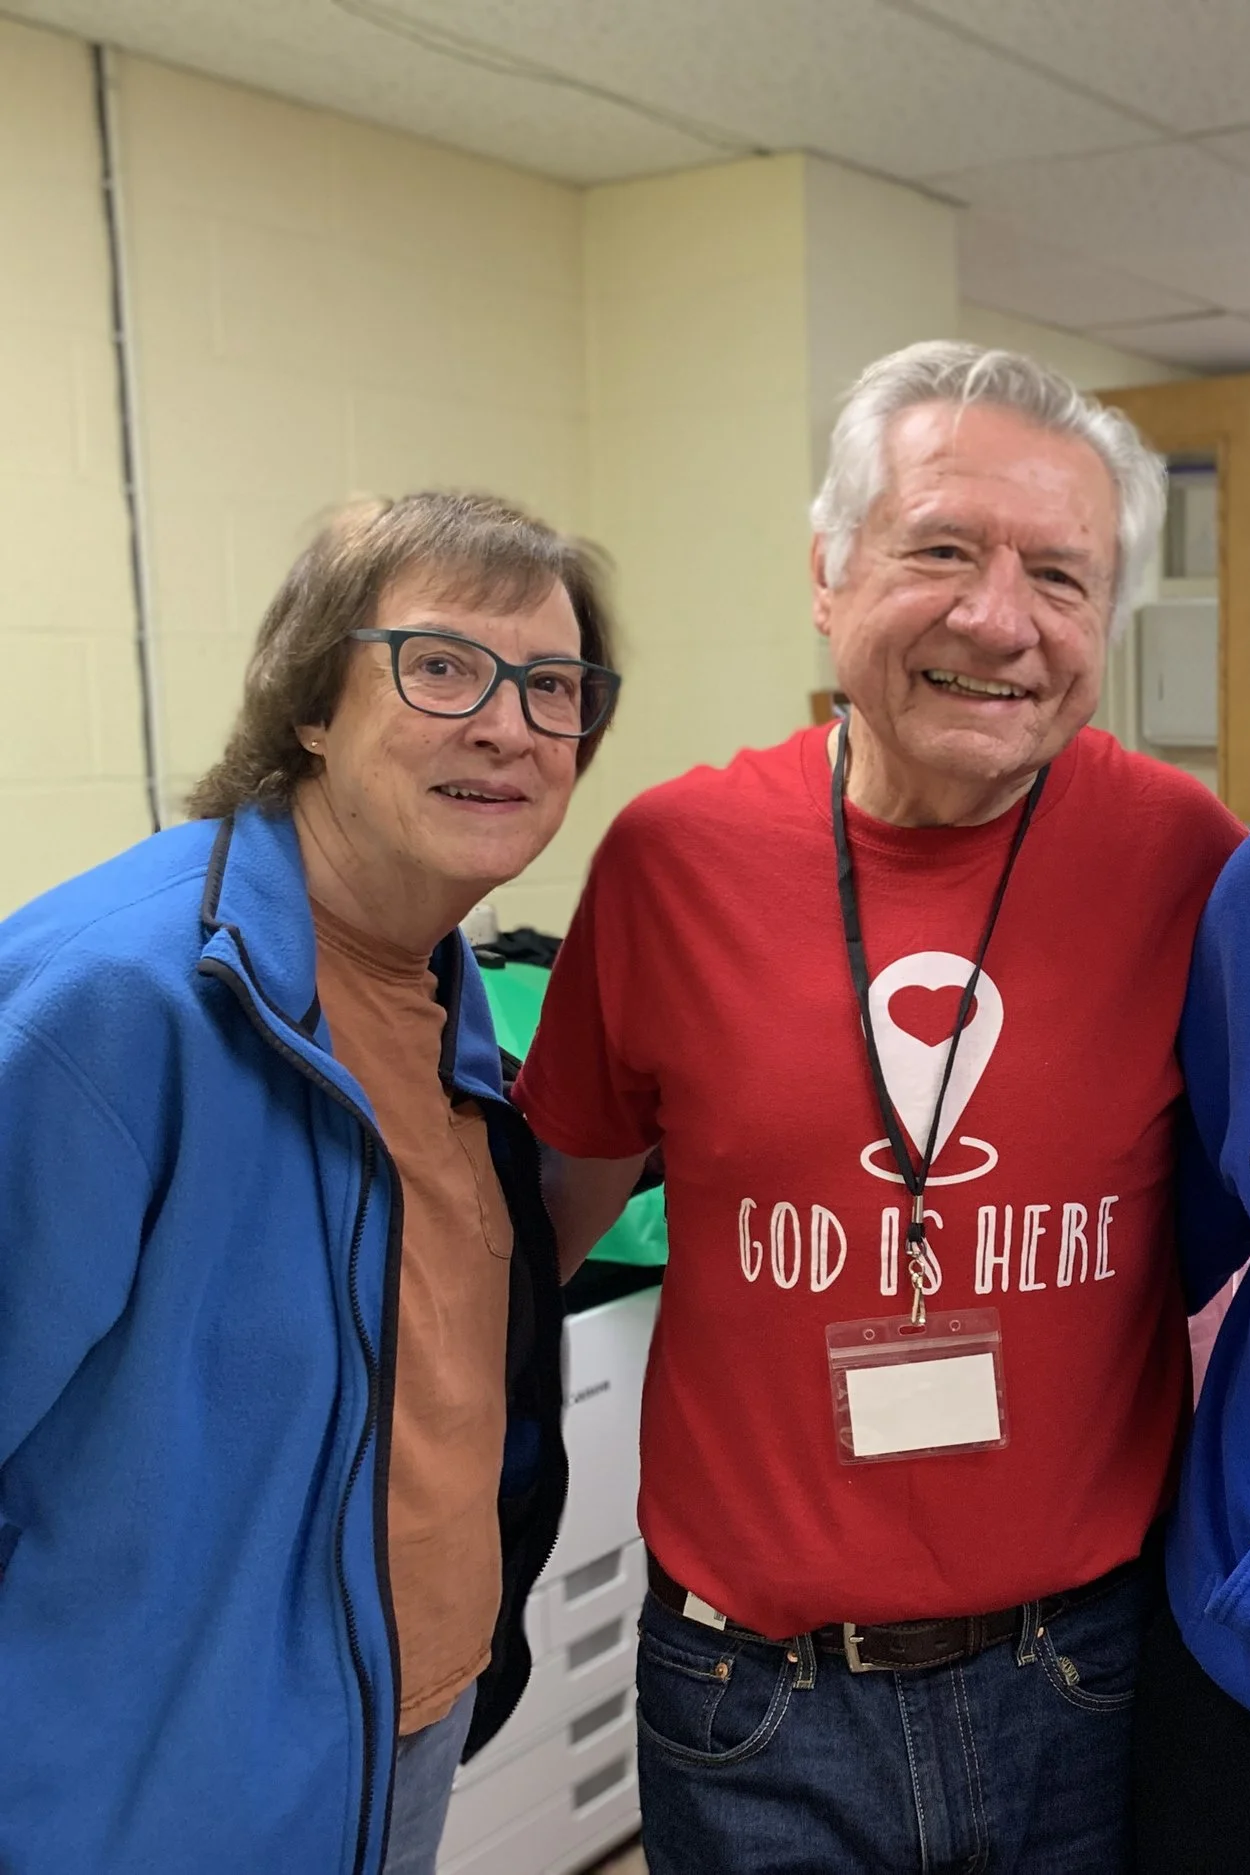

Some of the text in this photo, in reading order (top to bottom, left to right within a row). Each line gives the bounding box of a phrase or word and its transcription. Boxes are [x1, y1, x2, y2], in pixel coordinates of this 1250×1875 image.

[739, 1195, 1119, 1295] GOD IS HERE
